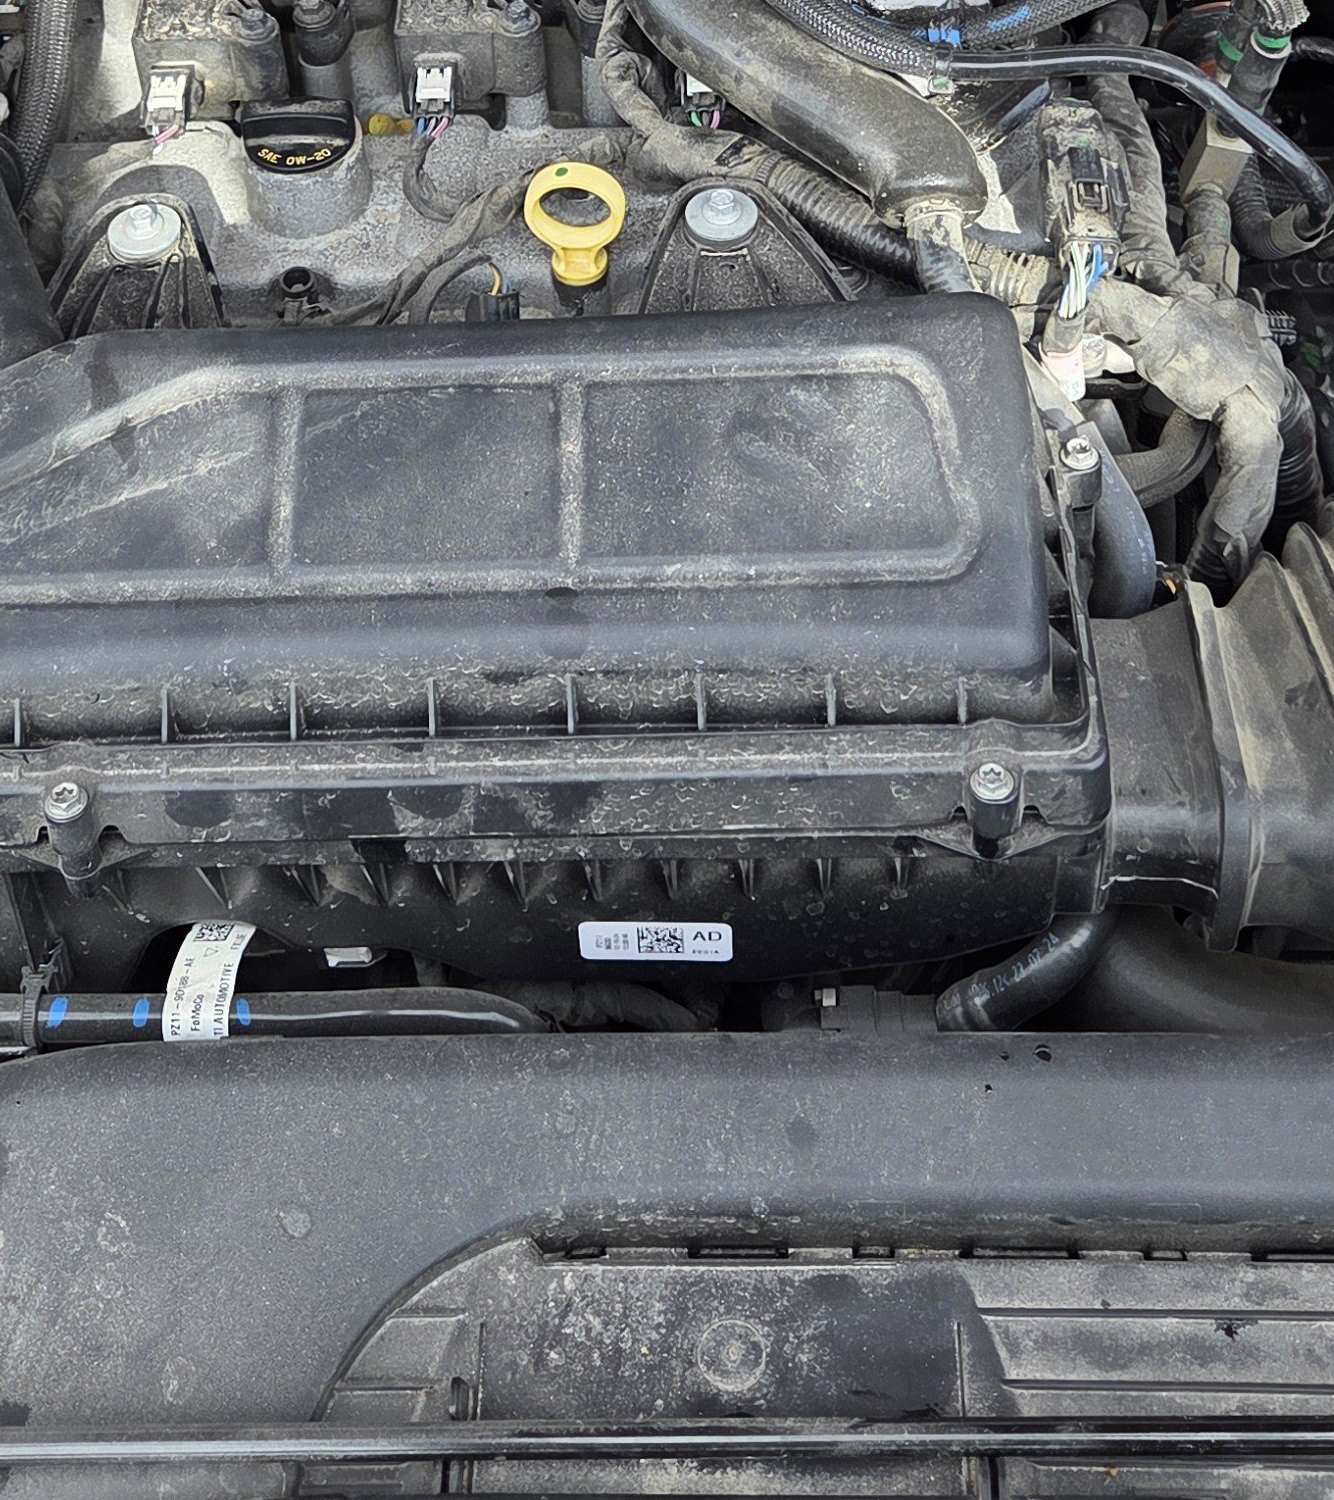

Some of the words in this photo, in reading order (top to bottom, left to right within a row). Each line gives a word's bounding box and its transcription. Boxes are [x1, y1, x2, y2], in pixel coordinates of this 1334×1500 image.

[257, 148, 282, 164] SAE
[286, 148, 332, 166] 0W-20
[692, 931, 722, 941] AD
[214, 962, 234, 1025] AUTOMOTIVE
[191, 993, 205, 1032] FoMoCo
[213, 1026, 224, 1036] TI
